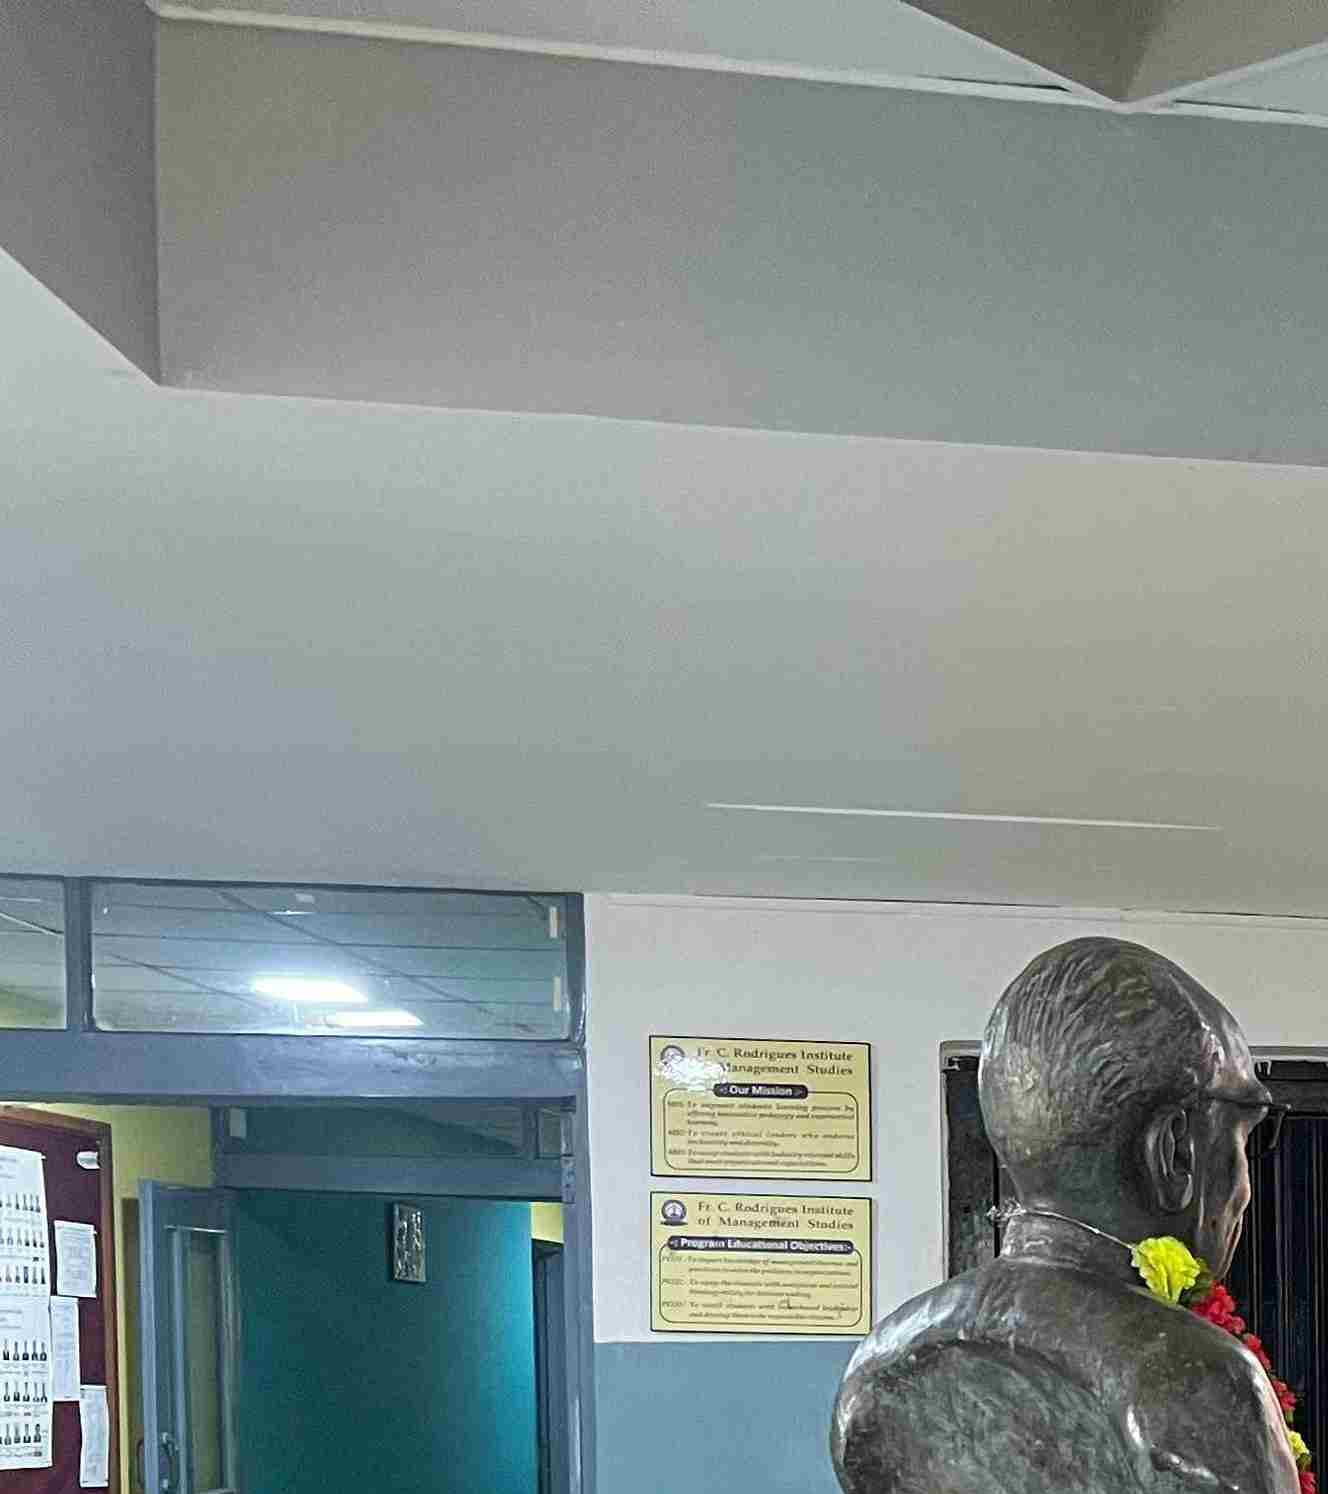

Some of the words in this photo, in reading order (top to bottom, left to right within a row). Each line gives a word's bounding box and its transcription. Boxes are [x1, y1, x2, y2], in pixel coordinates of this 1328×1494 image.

[734, 1047, 798, 1062] Rodrigues
[801, 1049, 854, 1061] Institute
[719, 1062, 799, 1075] Management
[807, 1064, 853, 1075] Studies
[729, 1085, 749, 1095] Our
[751, 1086, 793, 1096] Mission
[735, 1202, 798, 1216] Rodrigues
[802, 1205, 855, 1216] Institute
[697, 1216, 711, 1225] of
[719, 1217, 799, 1230] Management
[807, 1219, 854, 1230] Studies
[680, 1238, 725, 1249] Program
[727, 1239, 788, 1250] Educational
